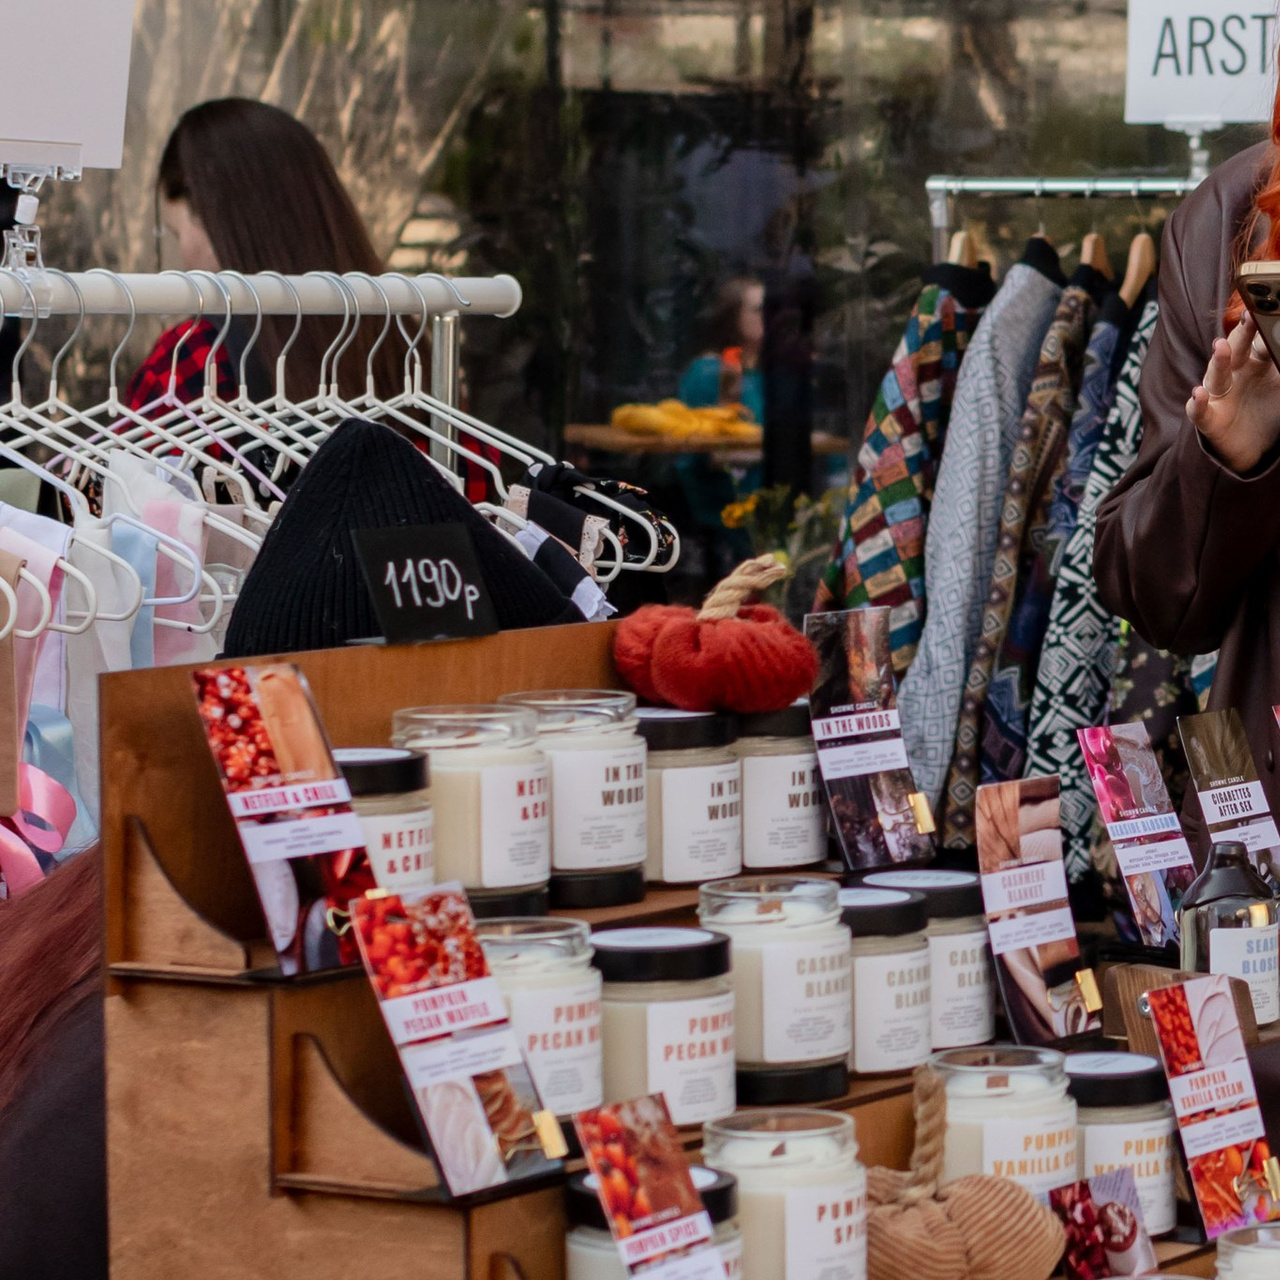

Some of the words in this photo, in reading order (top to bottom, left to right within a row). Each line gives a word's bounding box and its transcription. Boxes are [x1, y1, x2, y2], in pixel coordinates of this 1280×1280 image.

[1152, 14, 1276, 76] ARST
[821, 721, 832, 736] IN
[835, 719, 853, 734] THE
[855, 713, 891, 731] WOODS
[605, 766, 620, 783] IN
[1211, 787, 1252, 805] CIGARETTES
[1218, 802, 1240, 817] AFTER
[1239, 800, 1253, 813] SEX
[1001, 868, 1046, 889] CASHMERE
[528, 1026, 584, 1052] PECAN
[663, 1040, 717, 1062] PECAN
[1188, 1070, 1227, 1091] PUMPKIN
